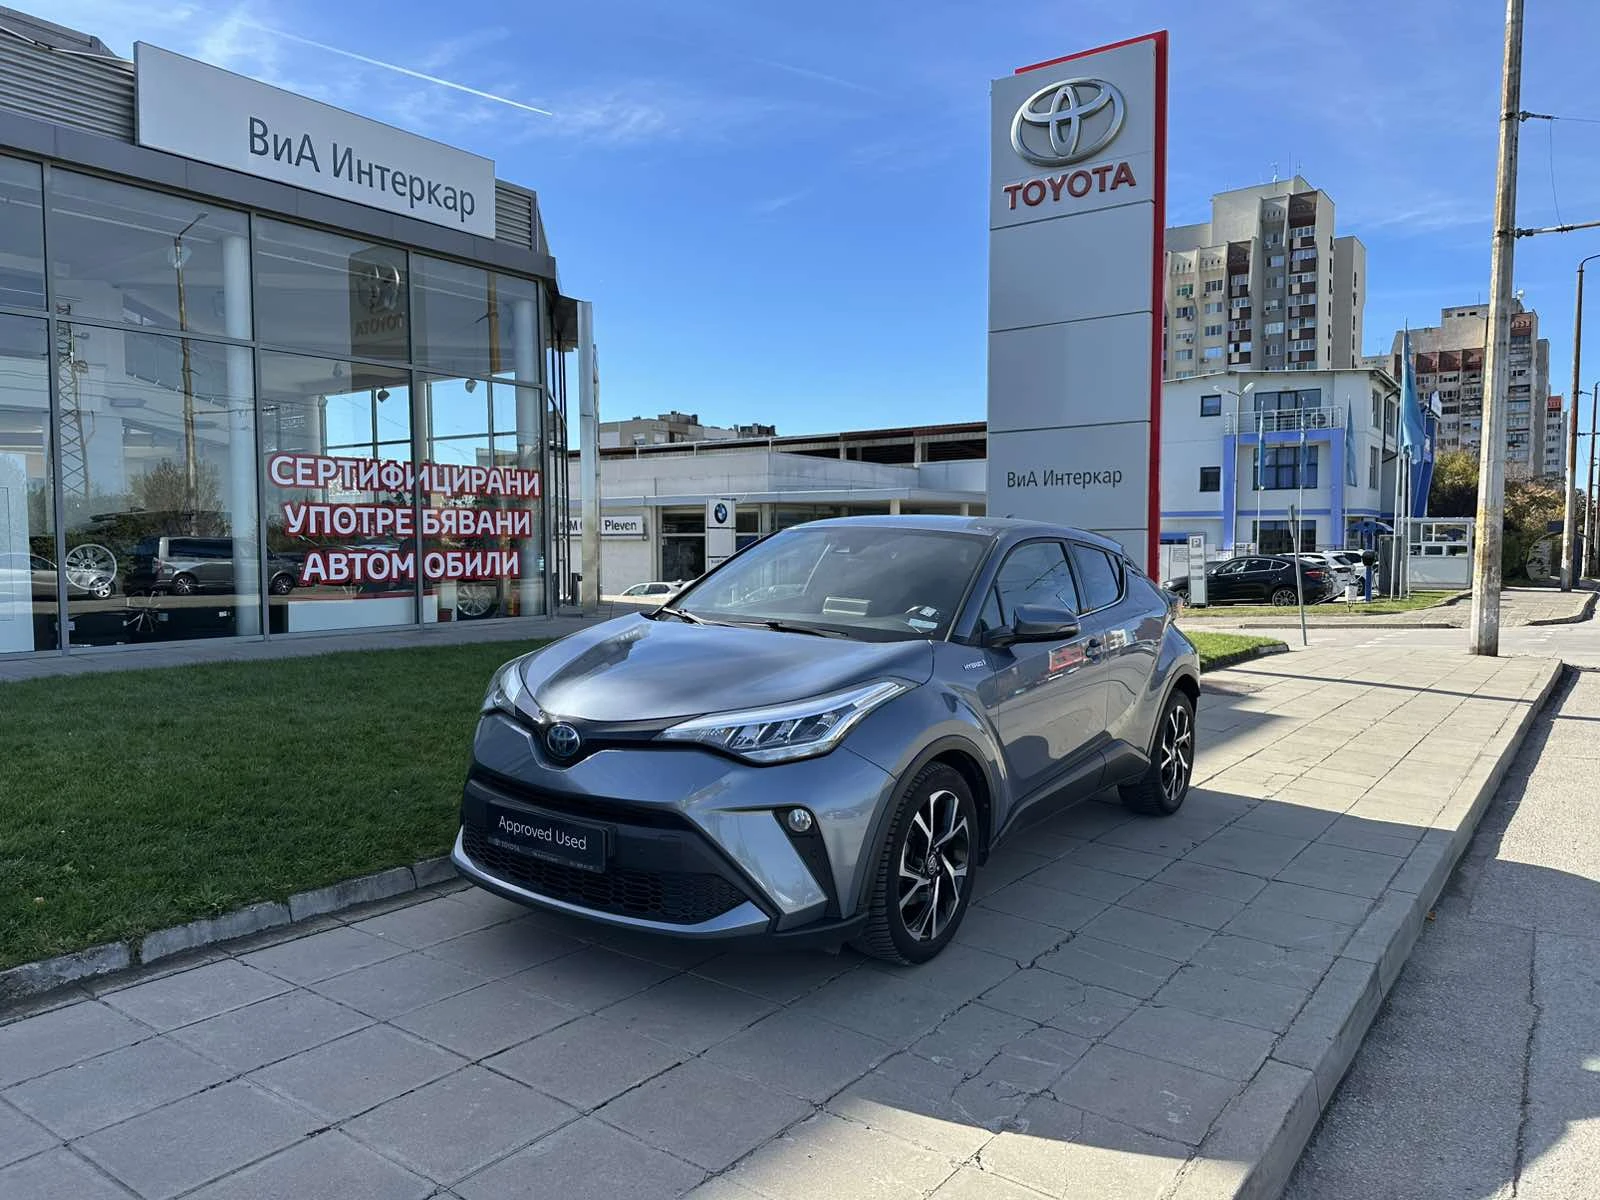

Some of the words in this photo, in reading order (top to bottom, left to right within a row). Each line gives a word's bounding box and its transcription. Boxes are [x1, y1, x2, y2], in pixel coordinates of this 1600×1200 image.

[248, 115, 321, 174] ВиА
[332, 140, 476, 223] Интеркар
[1003, 161, 1137, 211] TOYOTA
[270, 454, 541, 498] СЕРТИФИЦИРАНИ
[1007, 470, 1038, 488] ВиА
[1043, 468, 1122, 490] Интеркар
[605, 519, 637, 531] Pleven
[498, 815, 552, 842] Approved
[556, 829, 587, 850] Used
